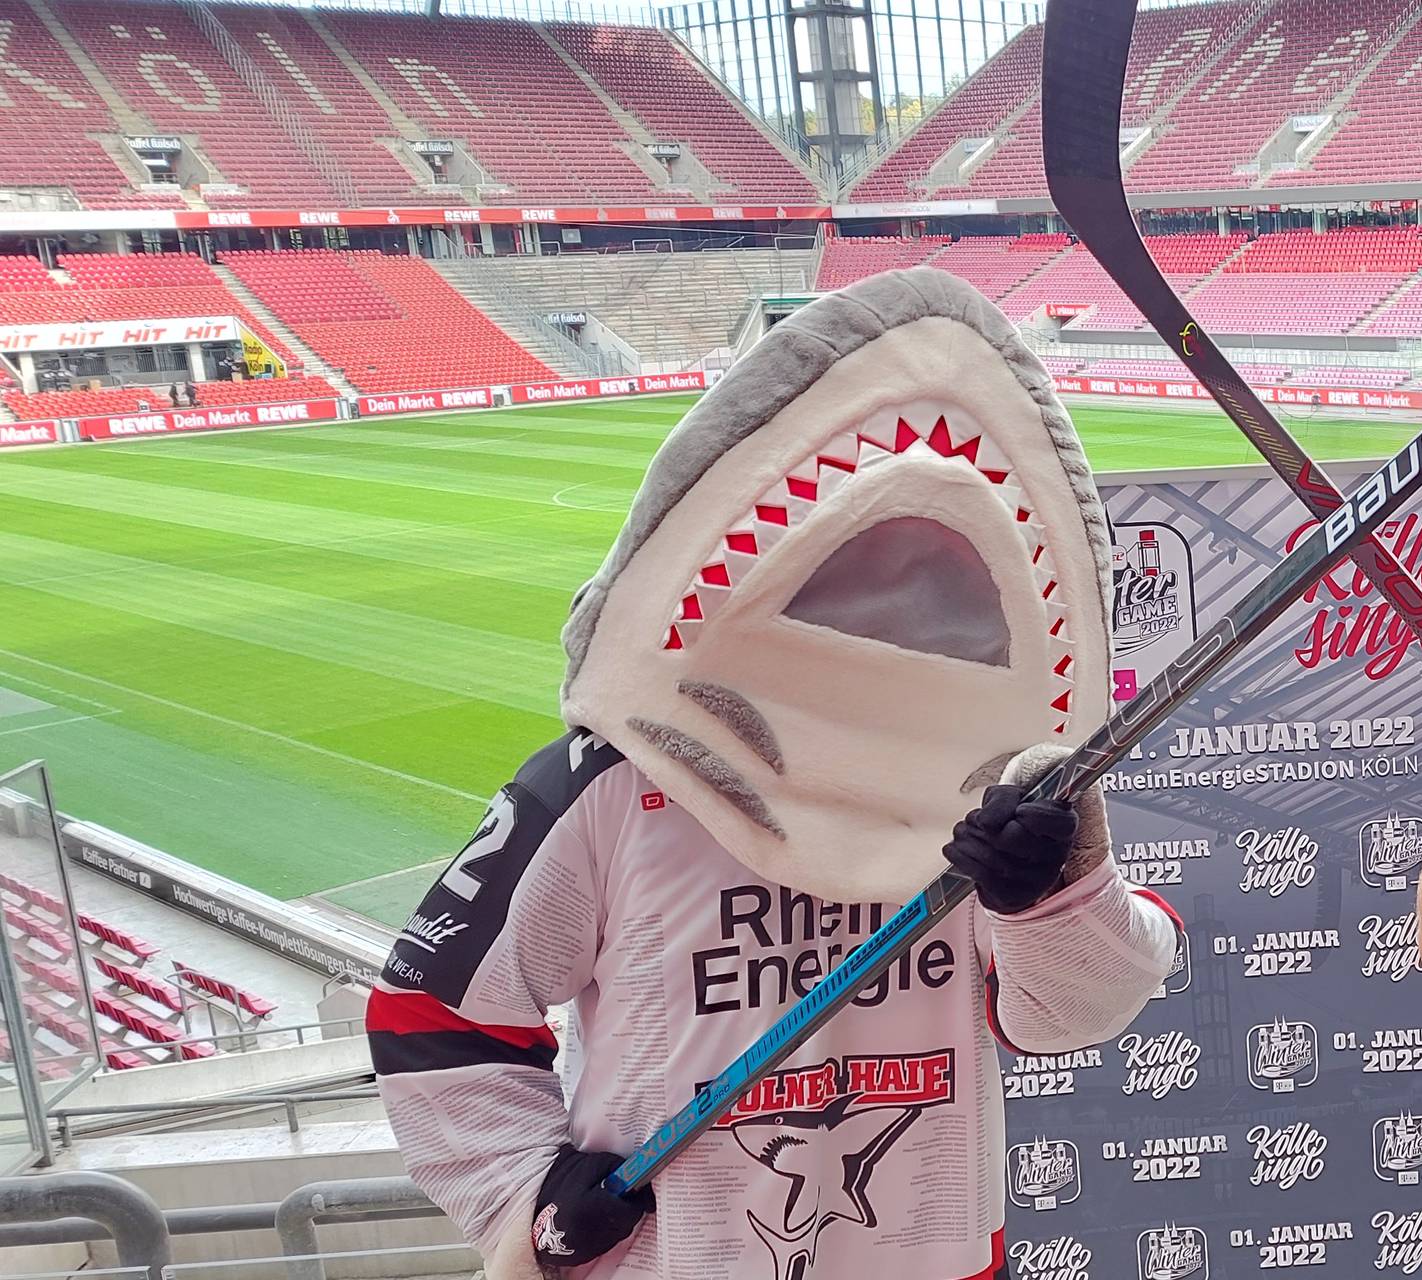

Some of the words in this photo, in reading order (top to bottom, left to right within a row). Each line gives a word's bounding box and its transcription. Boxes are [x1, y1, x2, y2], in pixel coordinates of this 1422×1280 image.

[209, 213, 250, 224] REWE
[300, 212, 339, 224] REWE
[444, 211, 480, 221] REWE
[522, 210, 555, 220] REWE
[58, 331, 104, 346] HIT
[123, 327, 167, 343] HIT
[185, 325, 227, 340] HIT
[527, 386, 551, 399] Dein
[554, 384, 587, 397] Markt
[645, 377, 667, 389] Dein
[670, 375, 700, 387] Markt
[1091, 381, 1116, 392] REWE
[1120, 383, 1135, 393] Dein
[1136, 384, 1158, 394] Markt
[1166, 384, 1193, 395] REWE
[368, 399, 395, 412] Dein
[399, 395, 435, 409] Markt
[441, 391, 486, 406] REWE
[1328, 392, 1360, 405] REWE
[1364, 394, 1382, 406] Dein
[1384, 394, 1411, 407] Markt
[109, 415, 167, 434] REWE
[173, 413, 205, 427] Dein
[209, 410, 250, 425] Markt
[257, 405, 308, 421] REWE
[1, 425, 49, 440] Markt
[1118, 596, 1177, 627] GAME
[1141, 616, 1178, 635] 2022
[1169, 721, 1320, 758] JANUAR
[1330, 716, 1416, 749] 2022
[1103, 758, 1354, 792] RheinEnergieSTADION
[1361, 754, 1418, 777] KÖLN
[1121, 839, 1211, 862] JANUAR
[82, 847, 108, 870] Kaffee
[108, 859, 138, 883] Partner
[173, 885, 227, 923] Hochwertige
[227, 905, 345, 974] Kaffee-Komplettlösungen
[1214, 935, 1245, 954] 01.
[1252, 929, 1340, 952] JANUAR
[1244, 950, 1312, 978] 2022
[1333, 1032, 1364, 1050] 01.
[847, 1054, 951, 1101] HAIE
[1005, 1072, 1075, 1099] 2022
[1102, 1142, 1134, 1160] 01.
[1141, 1135, 1228, 1156] JANUAR
[1132, 1156, 1201, 1182] 2022
[1230, 1229, 1261, 1247] 01.
[1268, 1221, 1353, 1244] JANUAR
[1259, 1242, 1327, 1269] 2022
